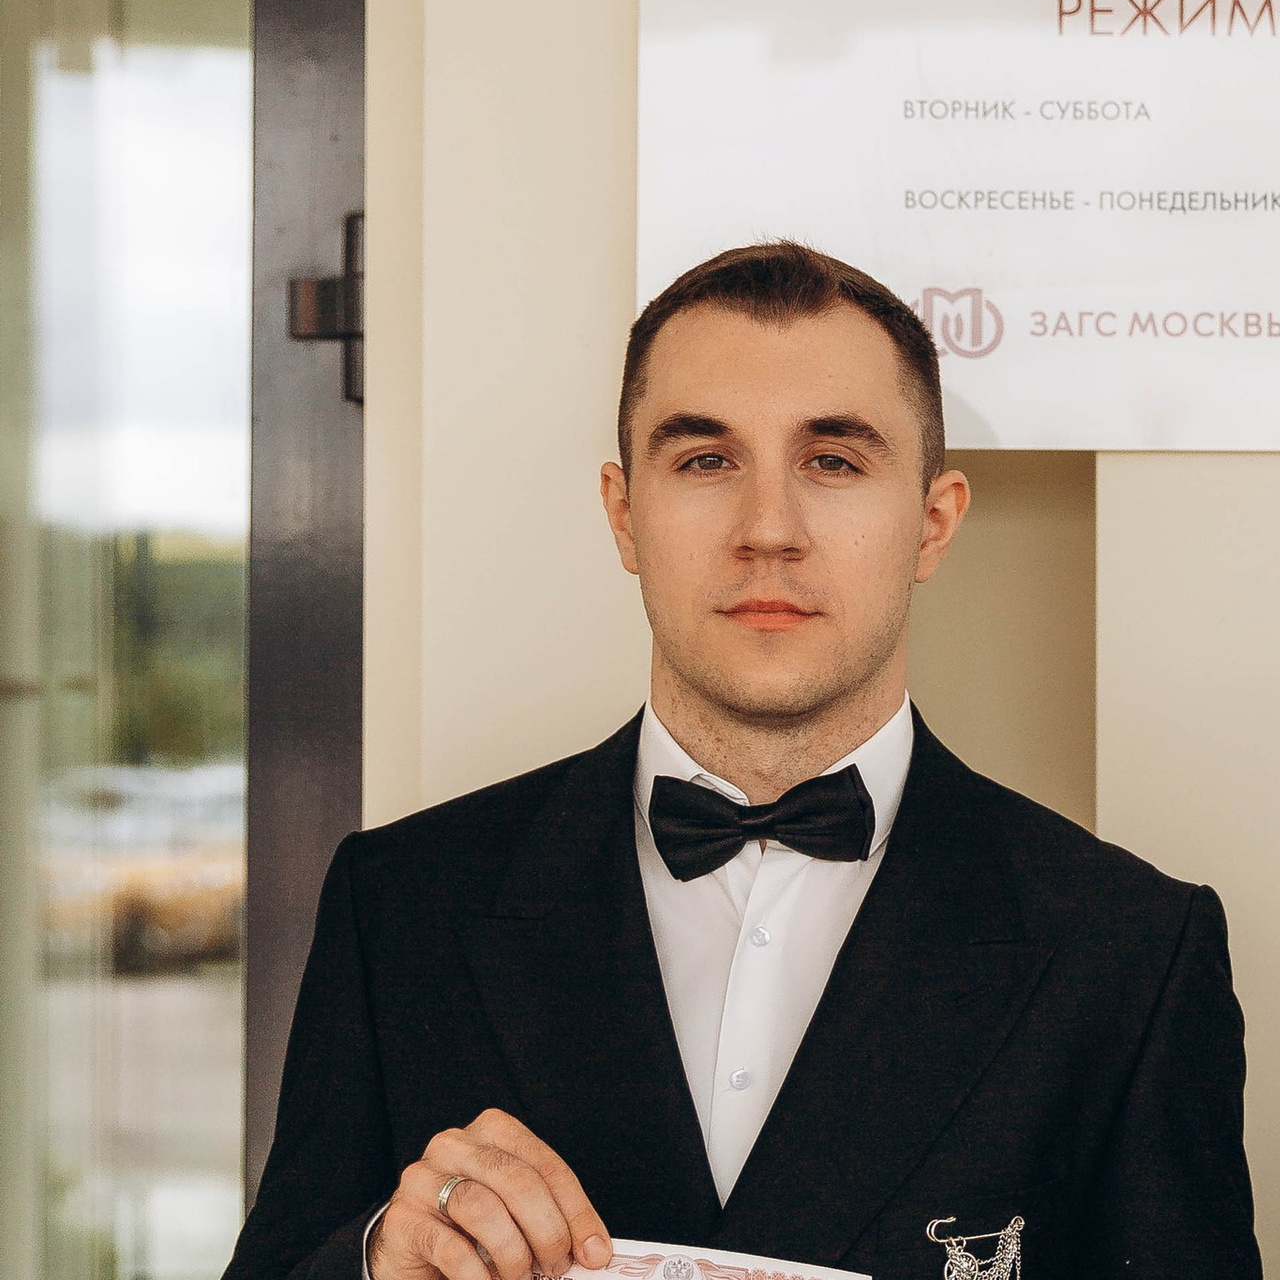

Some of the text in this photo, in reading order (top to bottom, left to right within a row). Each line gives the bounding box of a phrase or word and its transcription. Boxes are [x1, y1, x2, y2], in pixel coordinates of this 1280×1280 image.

[902, 99, 1016, 121] ВТОРНИК
[1038, 99, 1151, 121] СУББОТА
[904, 189, 1075, 211] ВОСКРЕСЕНЬЕ
[1029, 310, 1118, 338] ЗАГС
